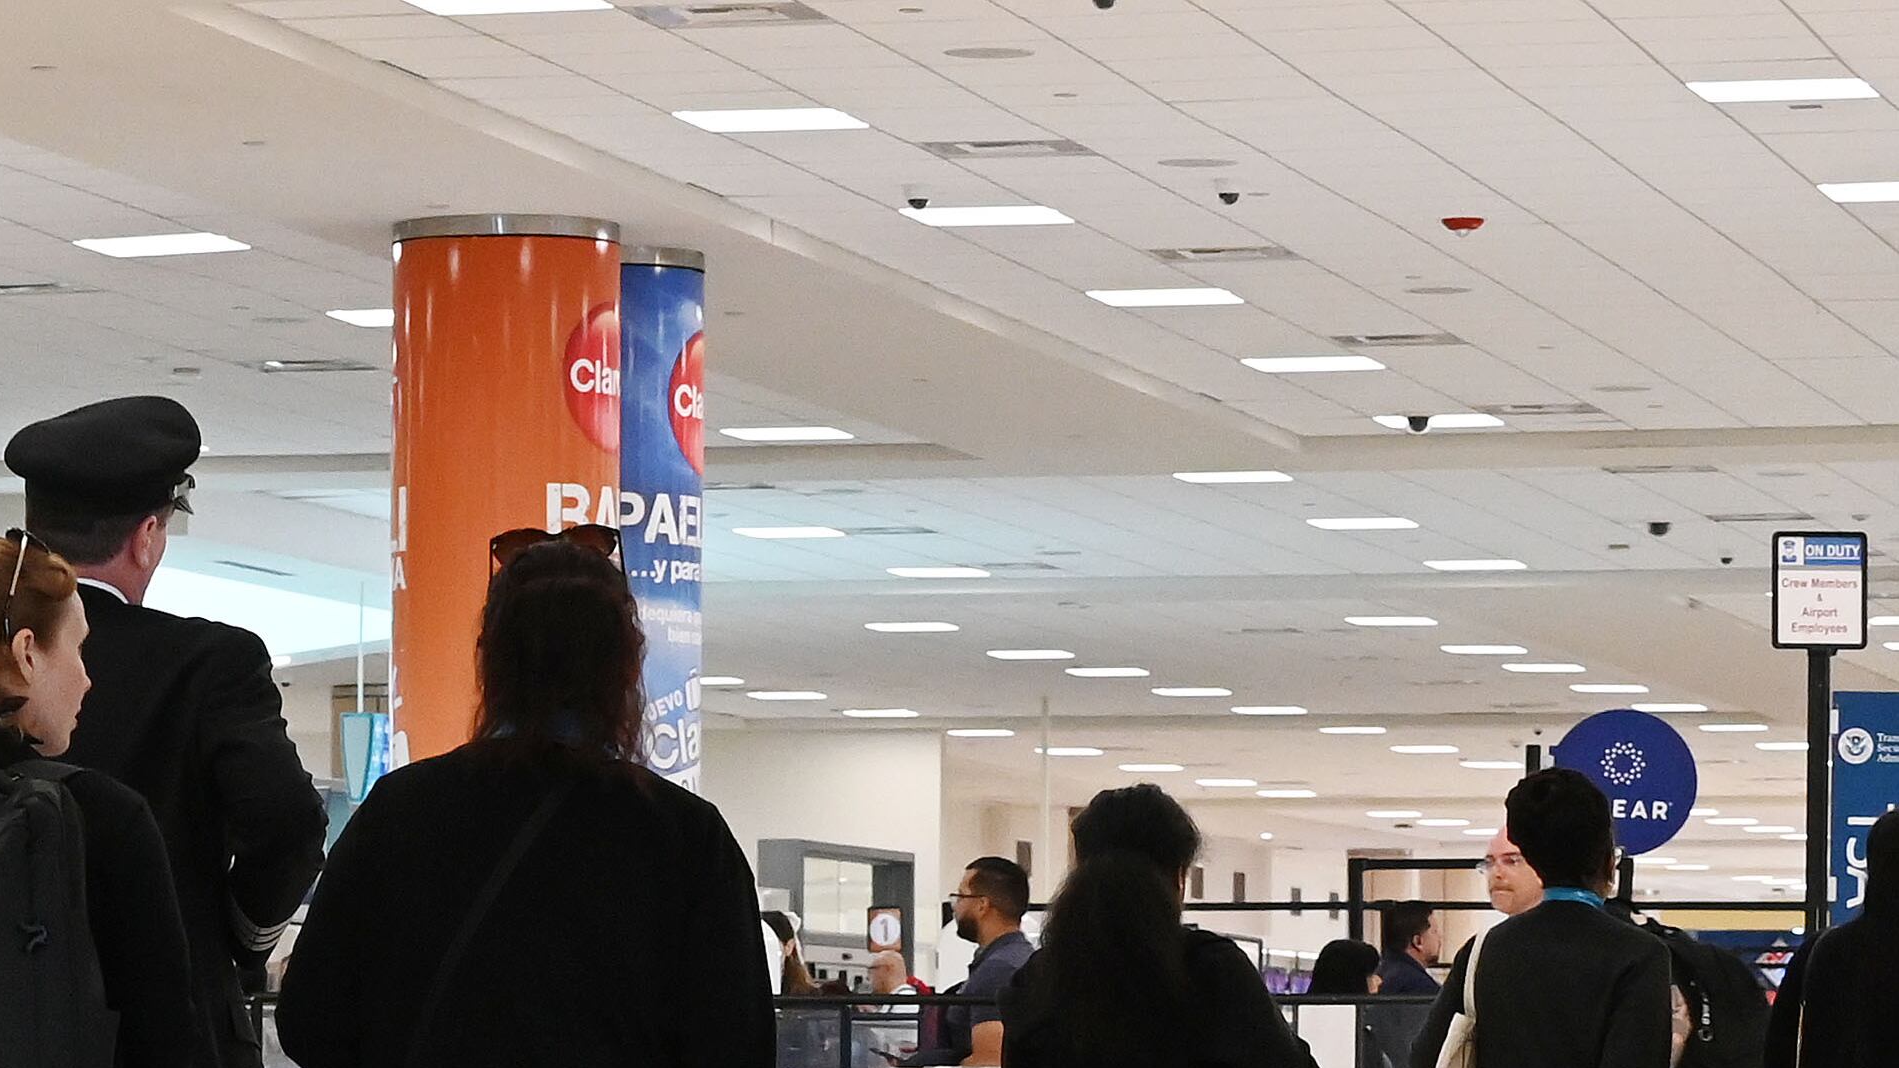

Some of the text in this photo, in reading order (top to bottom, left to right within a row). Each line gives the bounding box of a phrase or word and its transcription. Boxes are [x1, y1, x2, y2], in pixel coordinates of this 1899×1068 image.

[1805, 544, 1860, 557] ON DUTY
[1781, 577, 1858, 589] Crew Members
[1802, 607, 1838, 619] Airport
[1612, 799, 1668, 820] EAR
